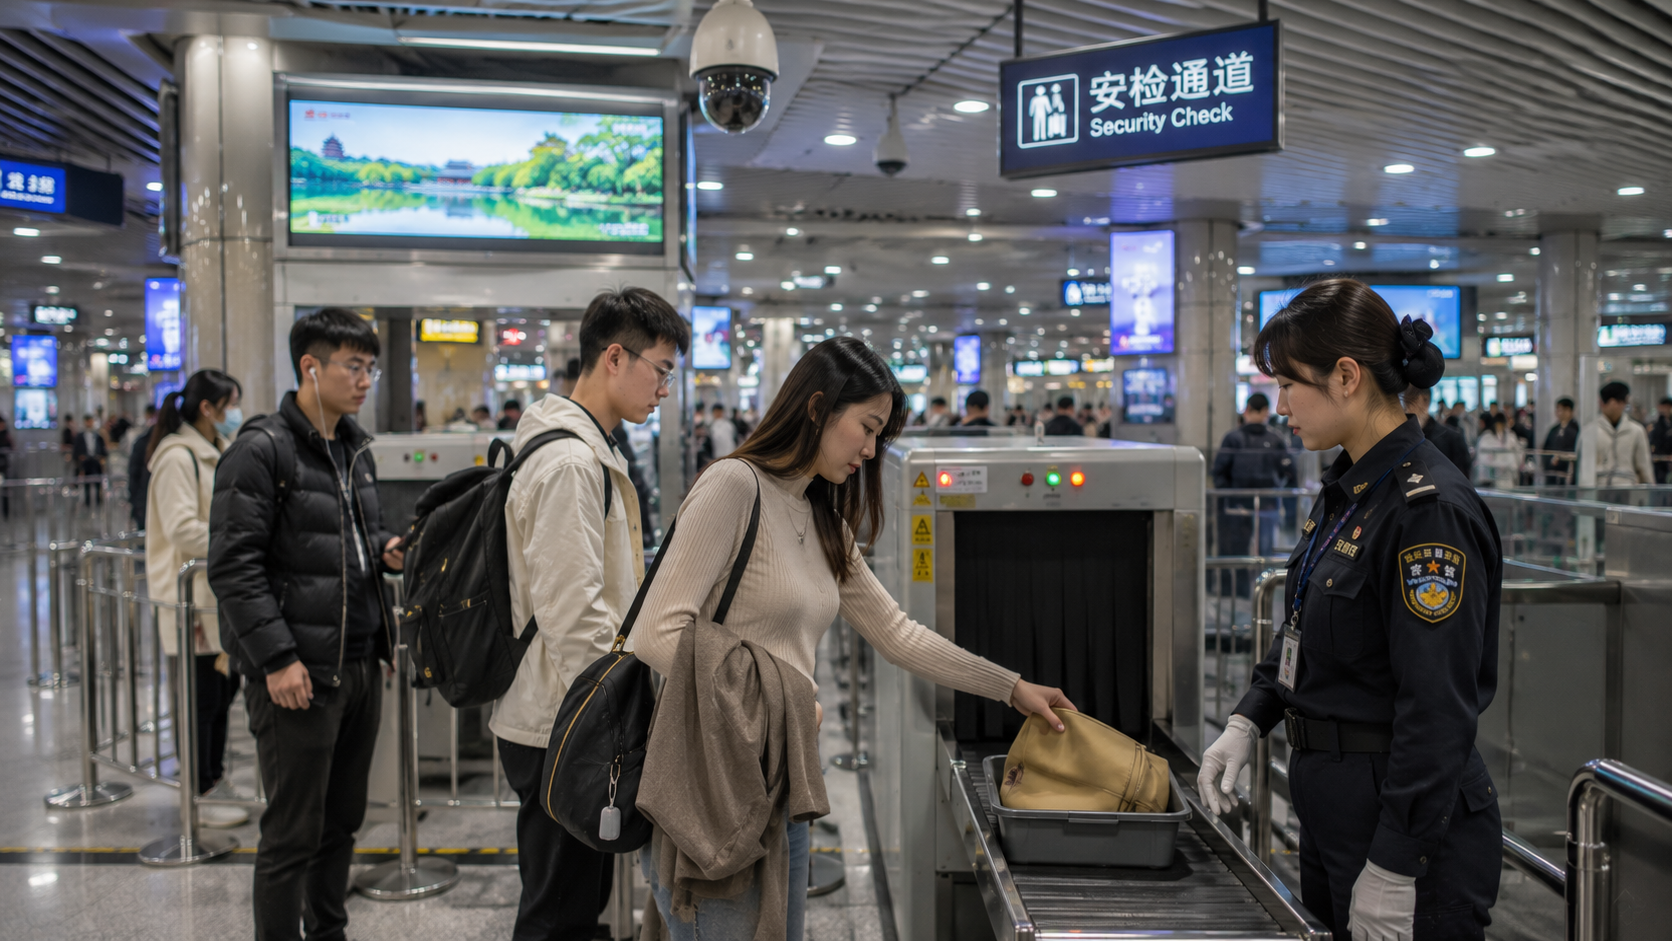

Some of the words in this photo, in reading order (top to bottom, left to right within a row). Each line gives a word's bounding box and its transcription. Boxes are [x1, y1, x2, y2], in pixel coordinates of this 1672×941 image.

[1089, 50, 1254, 114] 安检通道
[1089, 111, 1167, 138] Security
[1171, 101, 1234, 128] Check
